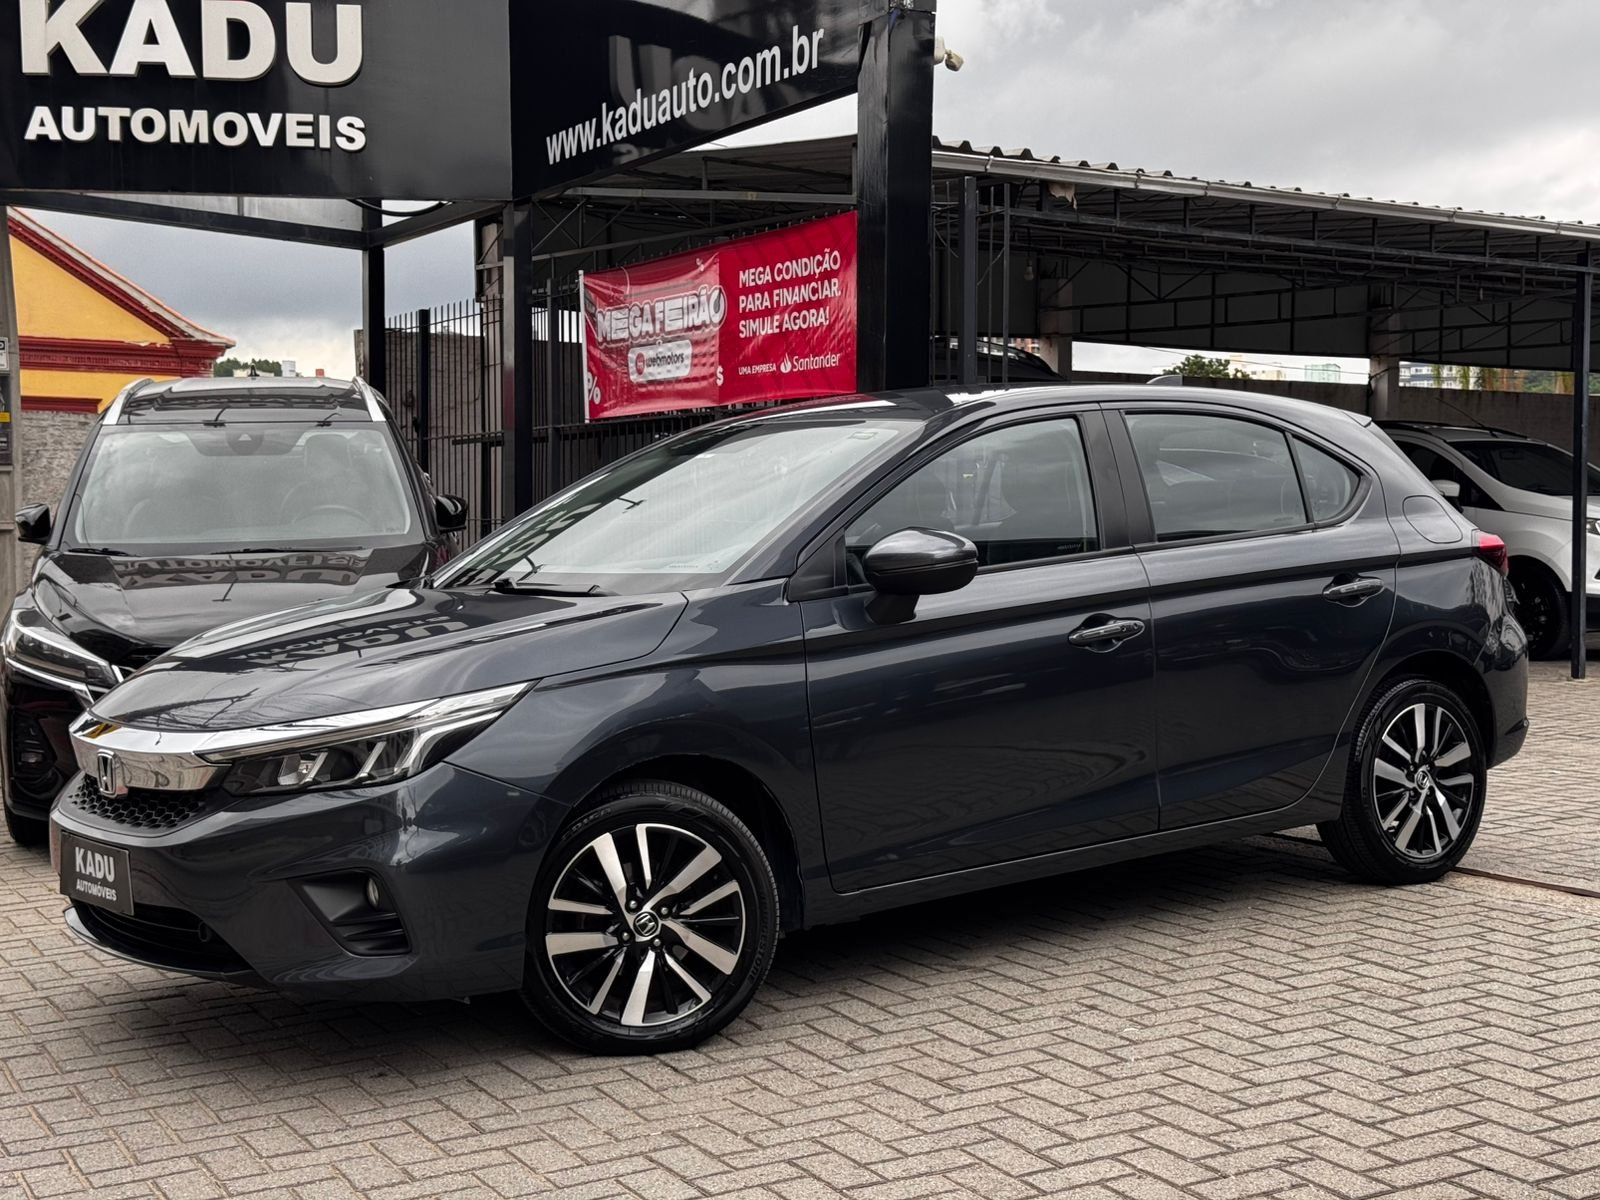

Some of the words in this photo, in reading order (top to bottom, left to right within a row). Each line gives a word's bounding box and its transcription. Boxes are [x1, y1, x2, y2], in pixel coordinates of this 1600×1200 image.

[19, 0, 363, 87] KADU
[546, 24, 825, 166] www.kaduauto.com.br
[24, 105, 367, 152] AUTOMOVEIS
[739, 265, 772, 288] MEGA
[774, 247, 841, 279] CONDIÇÃO
[739, 291, 771, 313] PARA
[773, 278, 841, 308] FINANCIAR.
[739, 315, 780, 338] SIMULE
[782, 306, 830, 332] AGORA!
[646, 351, 685, 368] webmotors
[738, 366, 752, 376] UMA
[752, 362, 777, 375] EMPRESA
[792, 351, 841, 372] Santander
[75, 846, 115, 883] KADU
